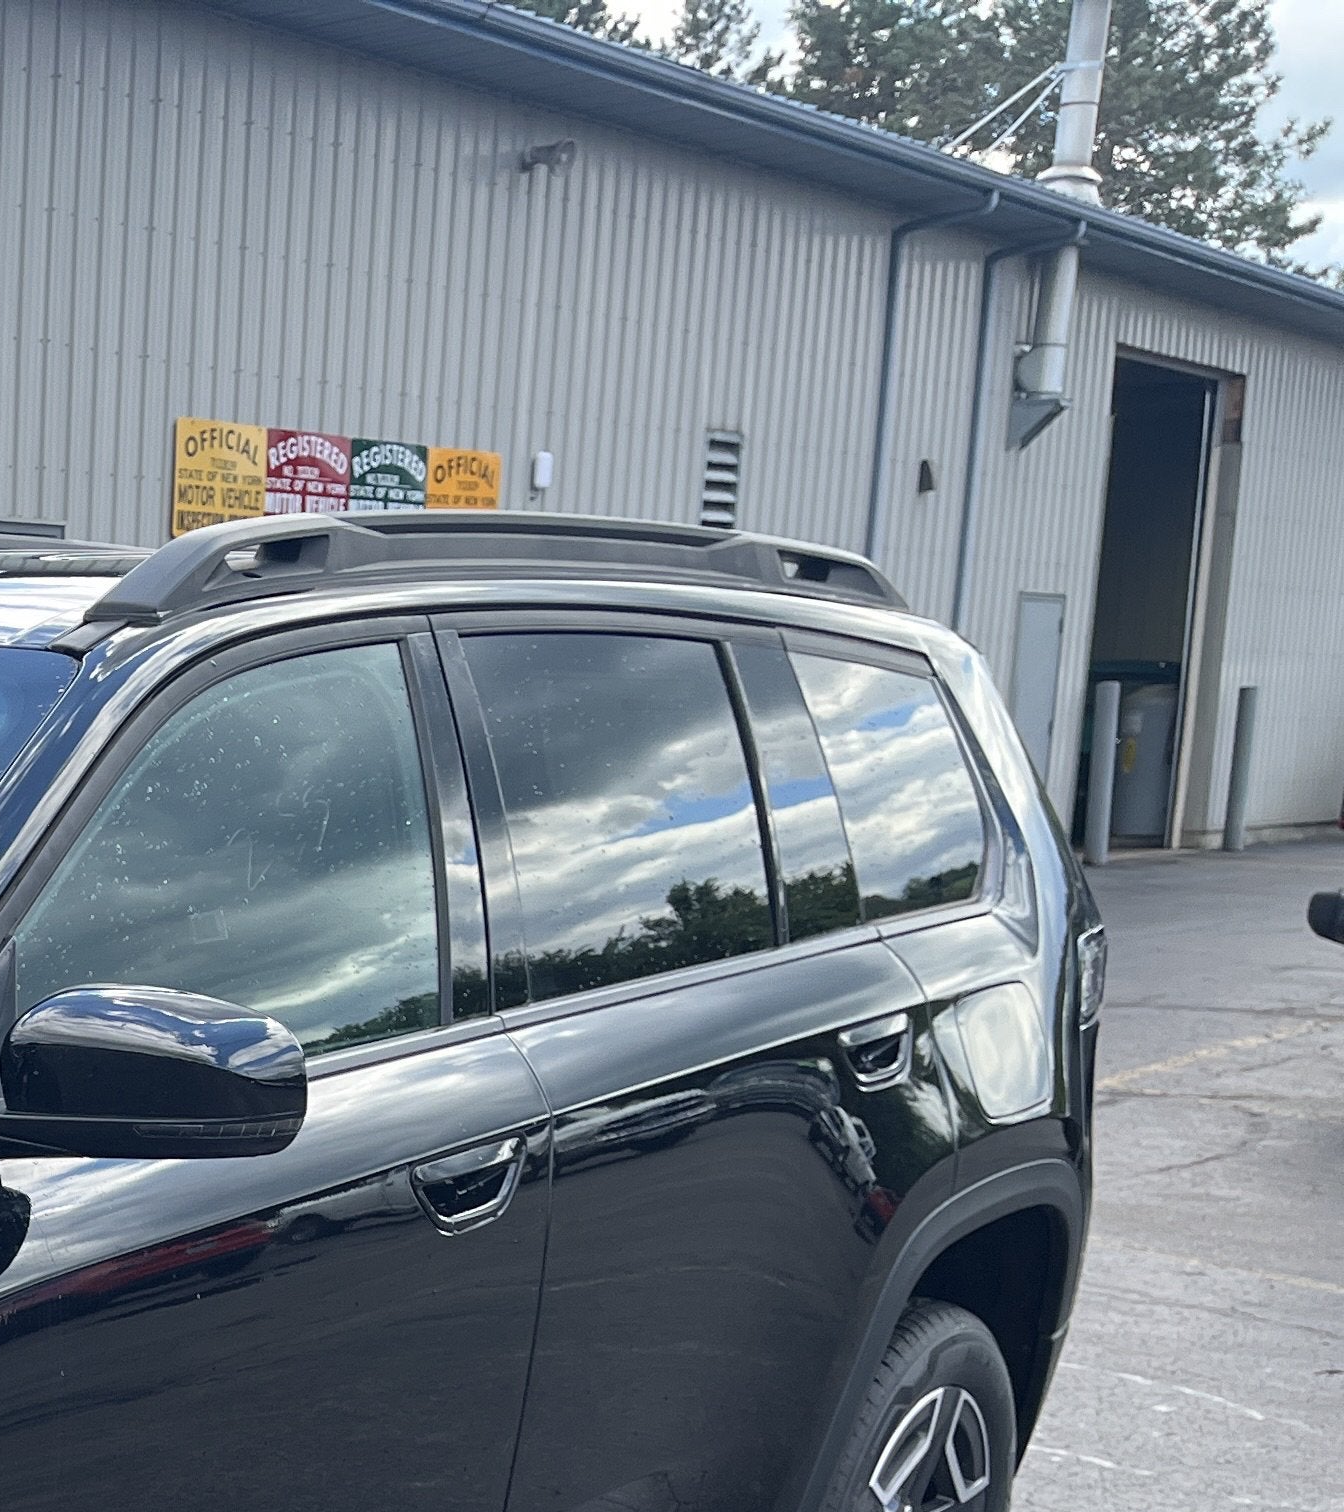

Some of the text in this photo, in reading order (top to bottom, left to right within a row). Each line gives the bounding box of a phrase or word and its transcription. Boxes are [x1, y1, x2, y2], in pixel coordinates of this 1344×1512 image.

[185, 427, 258, 466] OFFICIAL
[268, 435, 348, 475] REGISTERED
[352, 444, 426, 482] REGISTERED
[178, 468, 204, 481] STATE
[207, 470, 218, 482] OF
[266, 477, 292, 491] STATE
[434, 455, 495, 489] OFFICIAL
[178, 483, 260, 511] MOTOR VEHICLE
